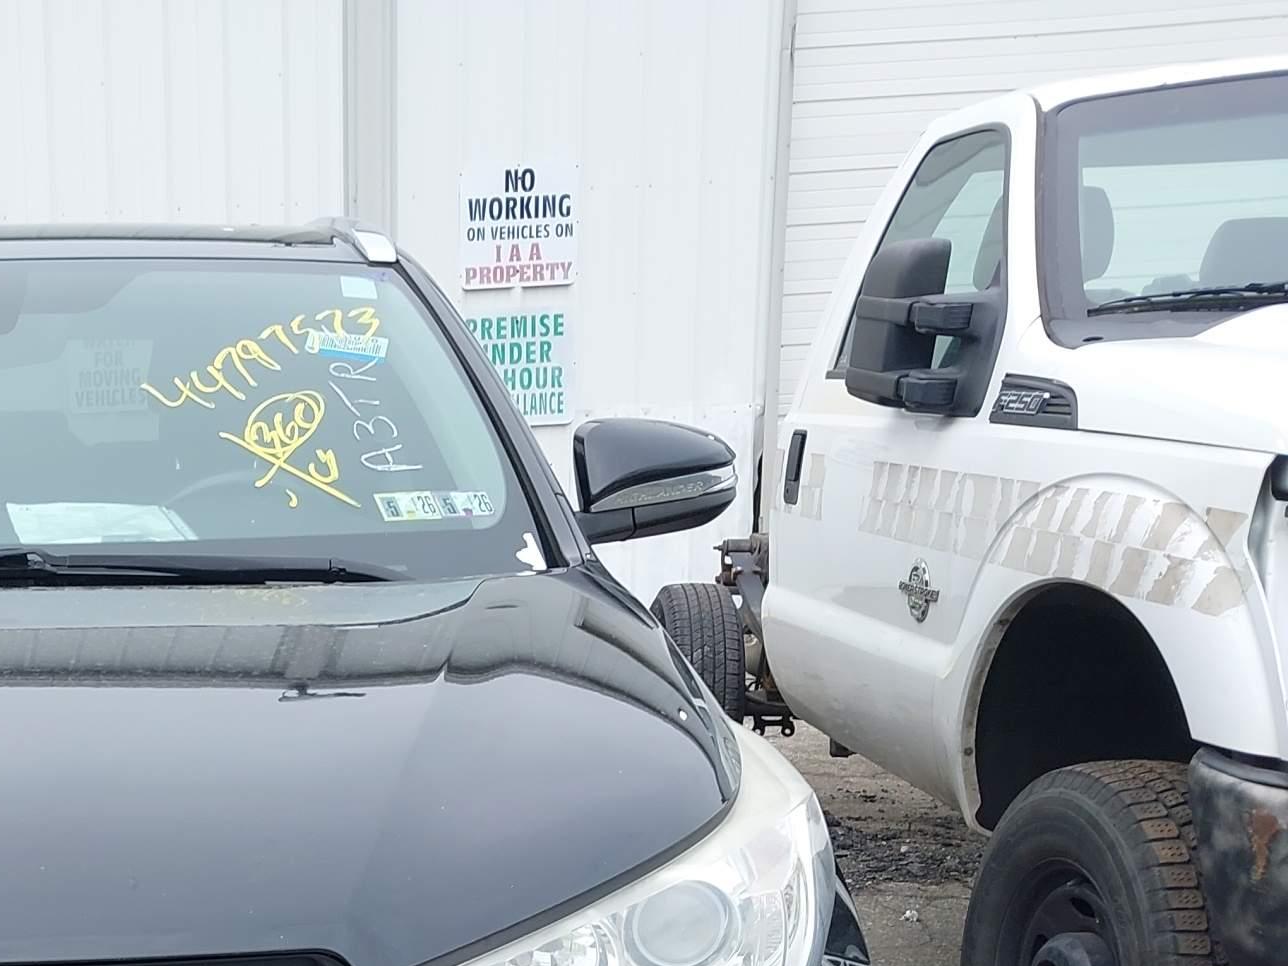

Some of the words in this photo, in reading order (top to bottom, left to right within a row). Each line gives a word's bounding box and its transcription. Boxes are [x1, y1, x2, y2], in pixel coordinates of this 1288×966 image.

[505, 168, 535, 193] NO
[467, 193, 571, 222] WORKING
[466, 227, 485, 242] ON
[490, 223, 550, 240] VEHICLES
[555, 223, 573, 238] ON
[464, 261, 572, 285] PROPERTY
[94, 351, 123, 368] FOR
[140, 306, 381, 409] 44797573
[482, 340, 552, 366] NDER
[78, 367, 142, 388] MOVING
[503, 366, 563, 391] HOUR
[74, 387, 146, 408] VEHICLES
[249, 396, 320, 453] 360
[416, 495, 436, 514] 26
[473, 493, 493, 513] 26
